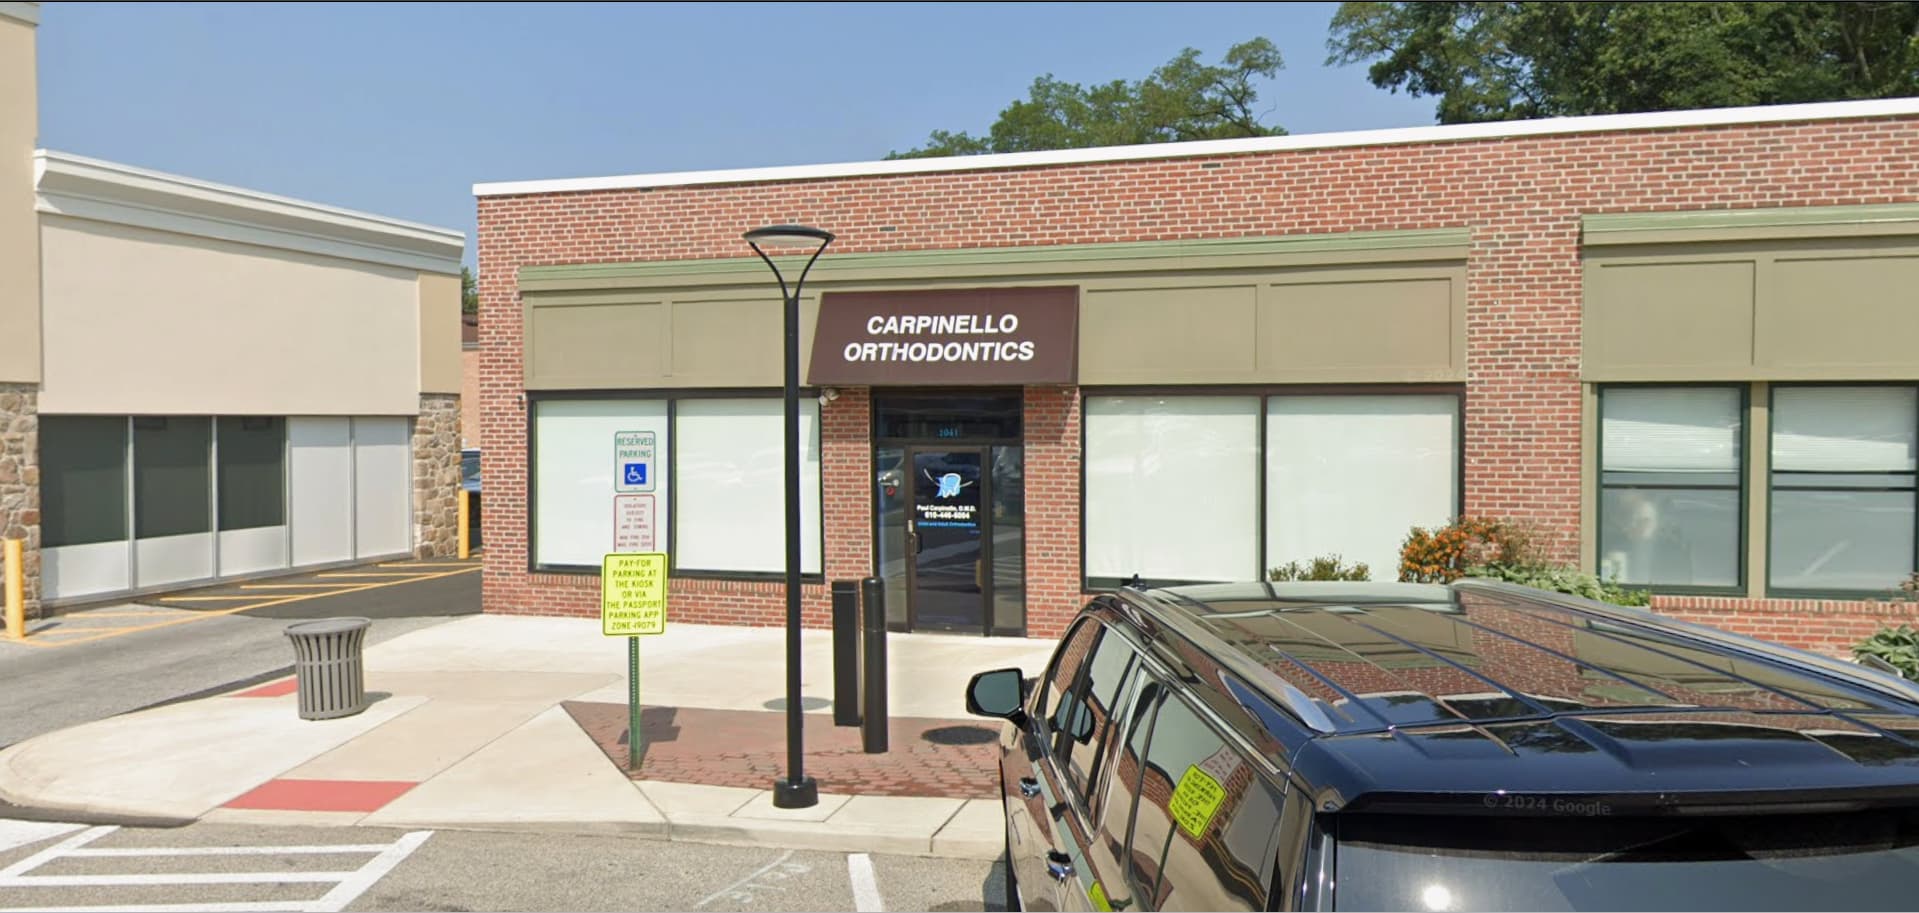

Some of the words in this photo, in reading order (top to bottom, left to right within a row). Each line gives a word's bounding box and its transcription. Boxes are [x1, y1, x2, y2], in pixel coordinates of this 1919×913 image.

[867, 314, 1018, 334] CARPINELLO
[844, 341, 1034, 361] ORTHODONTICS
[616, 437, 654, 446] RESERVED
[619, 450, 652, 458] PARKING
[648, 569, 657, 577] AT
[615, 580, 628, 588] THE
[632, 580, 654, 588] KIOSK
[621, 590, 632, 598] OR
[635, 590, 647, 598] VIA
[607, 601, 619, 609] THE
[623, 600, 661, 608] PASSPORT
[644, 611, 659, 619] APP
